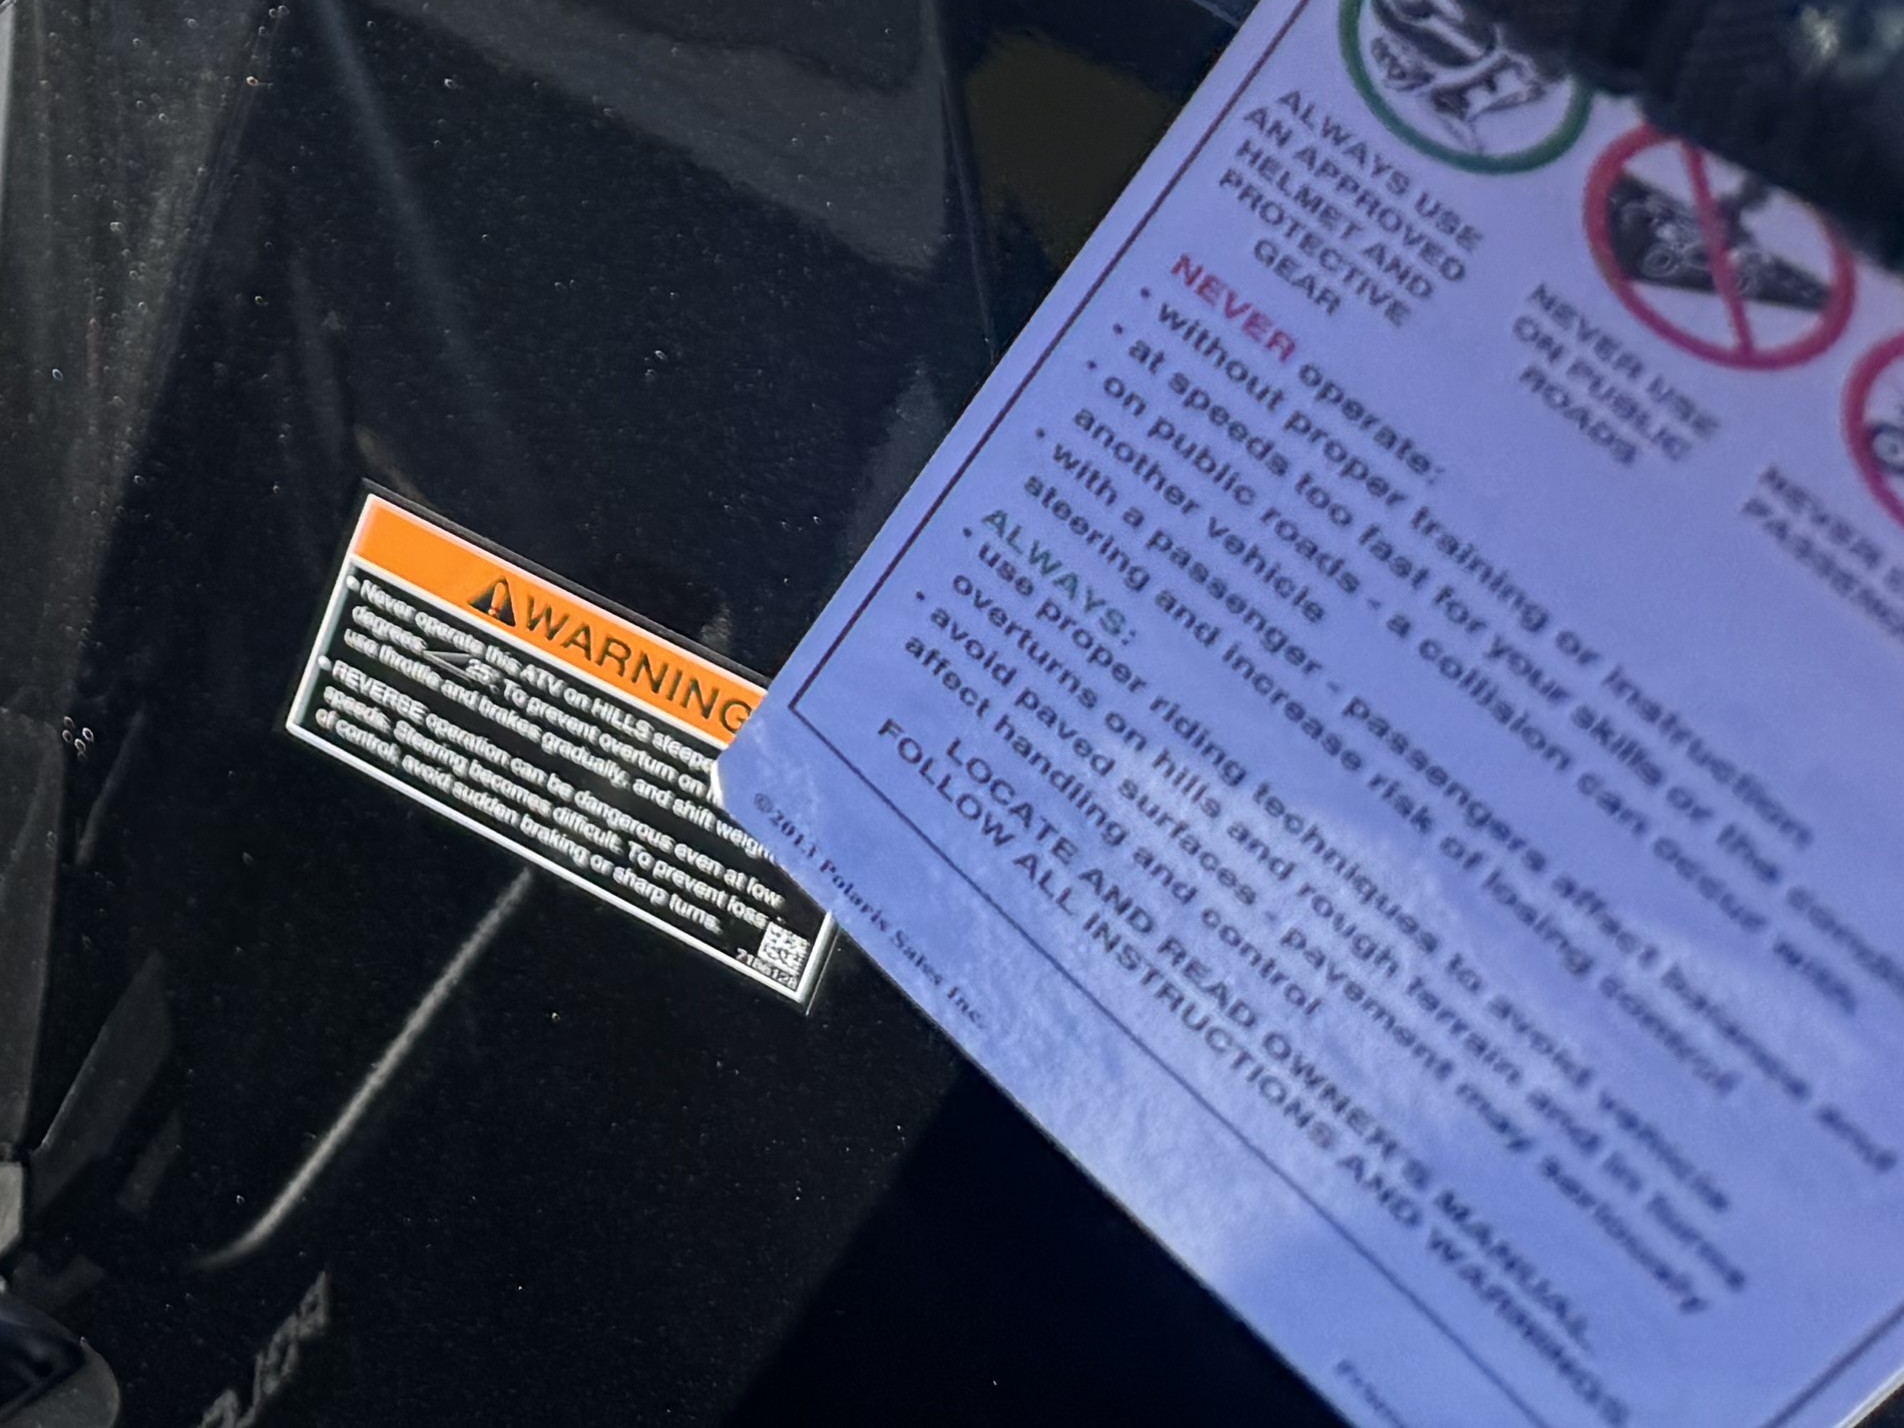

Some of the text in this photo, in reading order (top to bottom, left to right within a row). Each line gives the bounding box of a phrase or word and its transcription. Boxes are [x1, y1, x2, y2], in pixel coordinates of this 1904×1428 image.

[1217, 167, 1412, 328] PROTECTIVE
[1234, 138, 1438, 305] HELMET AND
[1242, 101, 1470, 287] AN APPROVED
[1250, 235, 1343, 317] GEAR
[1275, 85, 1484, 253] ALWAYS USE
[1127, 334, 1357, 532] at speeds too
[1154, 297, 1556, 638] without proper training
[1169, 251, 1445, 490] NEVER operate:
[981, 502, 1139, 649] ALWAYS:
[1049, 439, 1322, 686] with a passenger
[1072, 402, 1330, 626] another vehicle
[1100, 373, 1365, 597] on public roads
[518, 597, 750, 736] WARNING
[518, 661, 566, 699] ATV
[949, 569, 1229, 822] overturns on hills
[976, 542, 1250, 790] use proper riding
[1019, 470, 1367, 776] steering and increase
[904, 631, 1323, 1020] affect handling and control
[929, 601, 1262, 910] avoid paved surfaces
[819, 858, 888, 932] Polaris
[893, 929, 944, 986] Sales
[876, 717, 1340, 1157] FOLLOW ALL INSTRUCTIONS
[945, 736, 1261, 1035] LOCATE AND READ
